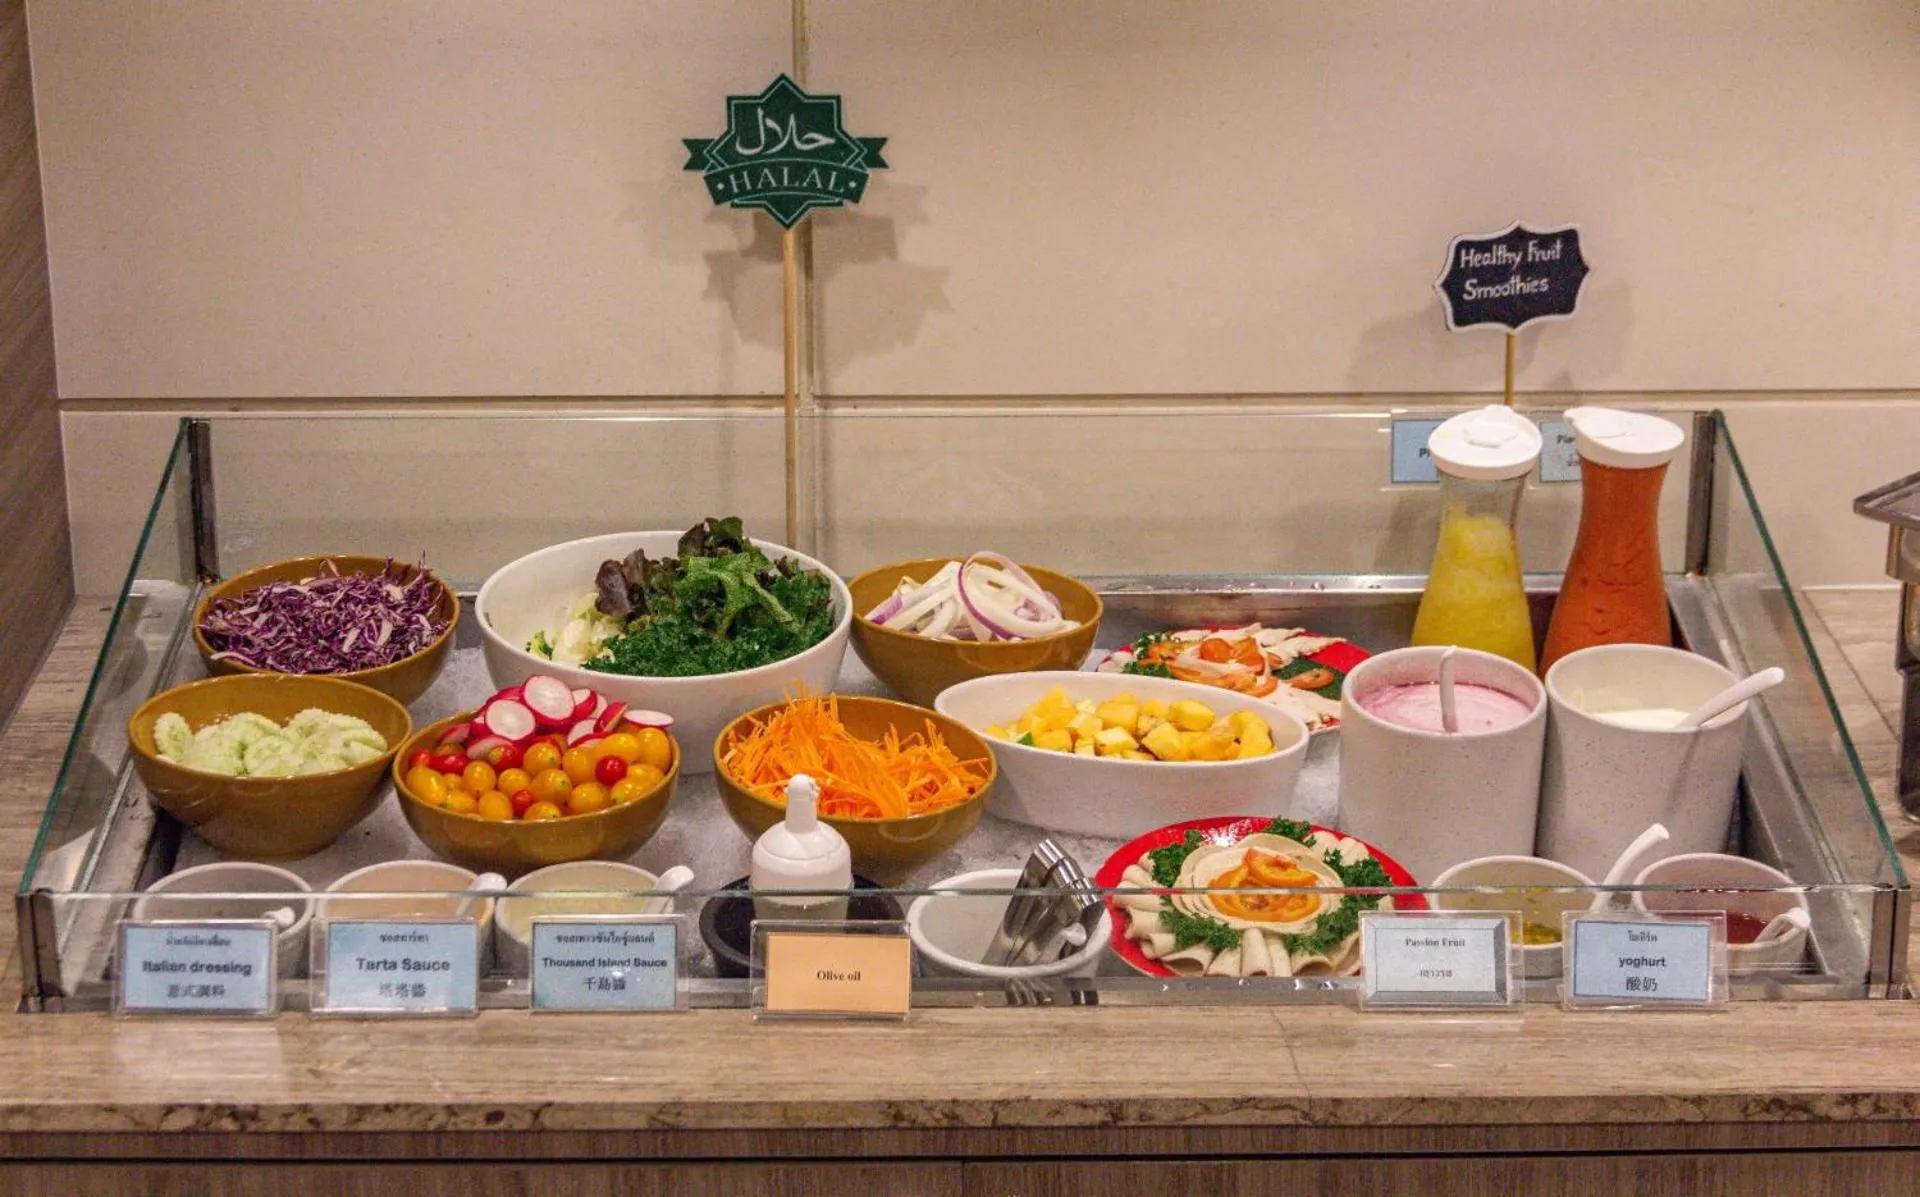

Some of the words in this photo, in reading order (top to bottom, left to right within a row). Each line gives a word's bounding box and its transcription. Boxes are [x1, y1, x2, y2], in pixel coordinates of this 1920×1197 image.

[735, 106, 836, 155] حلال
[729, 166, 845, 194] HALAL
[1459, 243, 1523, 270] Healthy
[1527, 239, 1563, 262] Fruit
[1462, 275, 1550, 301] Smoothies
[1405, 937, 1440, 947] Passion
[1441, 937, 1466, 947] Fruit
[142, 960, 187, 973] Italian
[189, 960, 253, 976] dressing
[356, 958, 398, 971] Tarta
[402, 958, 451, 971] Sauce
[542, 957, 596, 968] Thousand
[598, 957, 631, 968] Island
[633, 957, 668, 968] Sauce
[1618, 955, 1667, 969] yoghurt
[816, 969, 845, 981] Olive
[847, 970, 861, 981] oil
[1626, 976, 1658, 992] 酸奶
